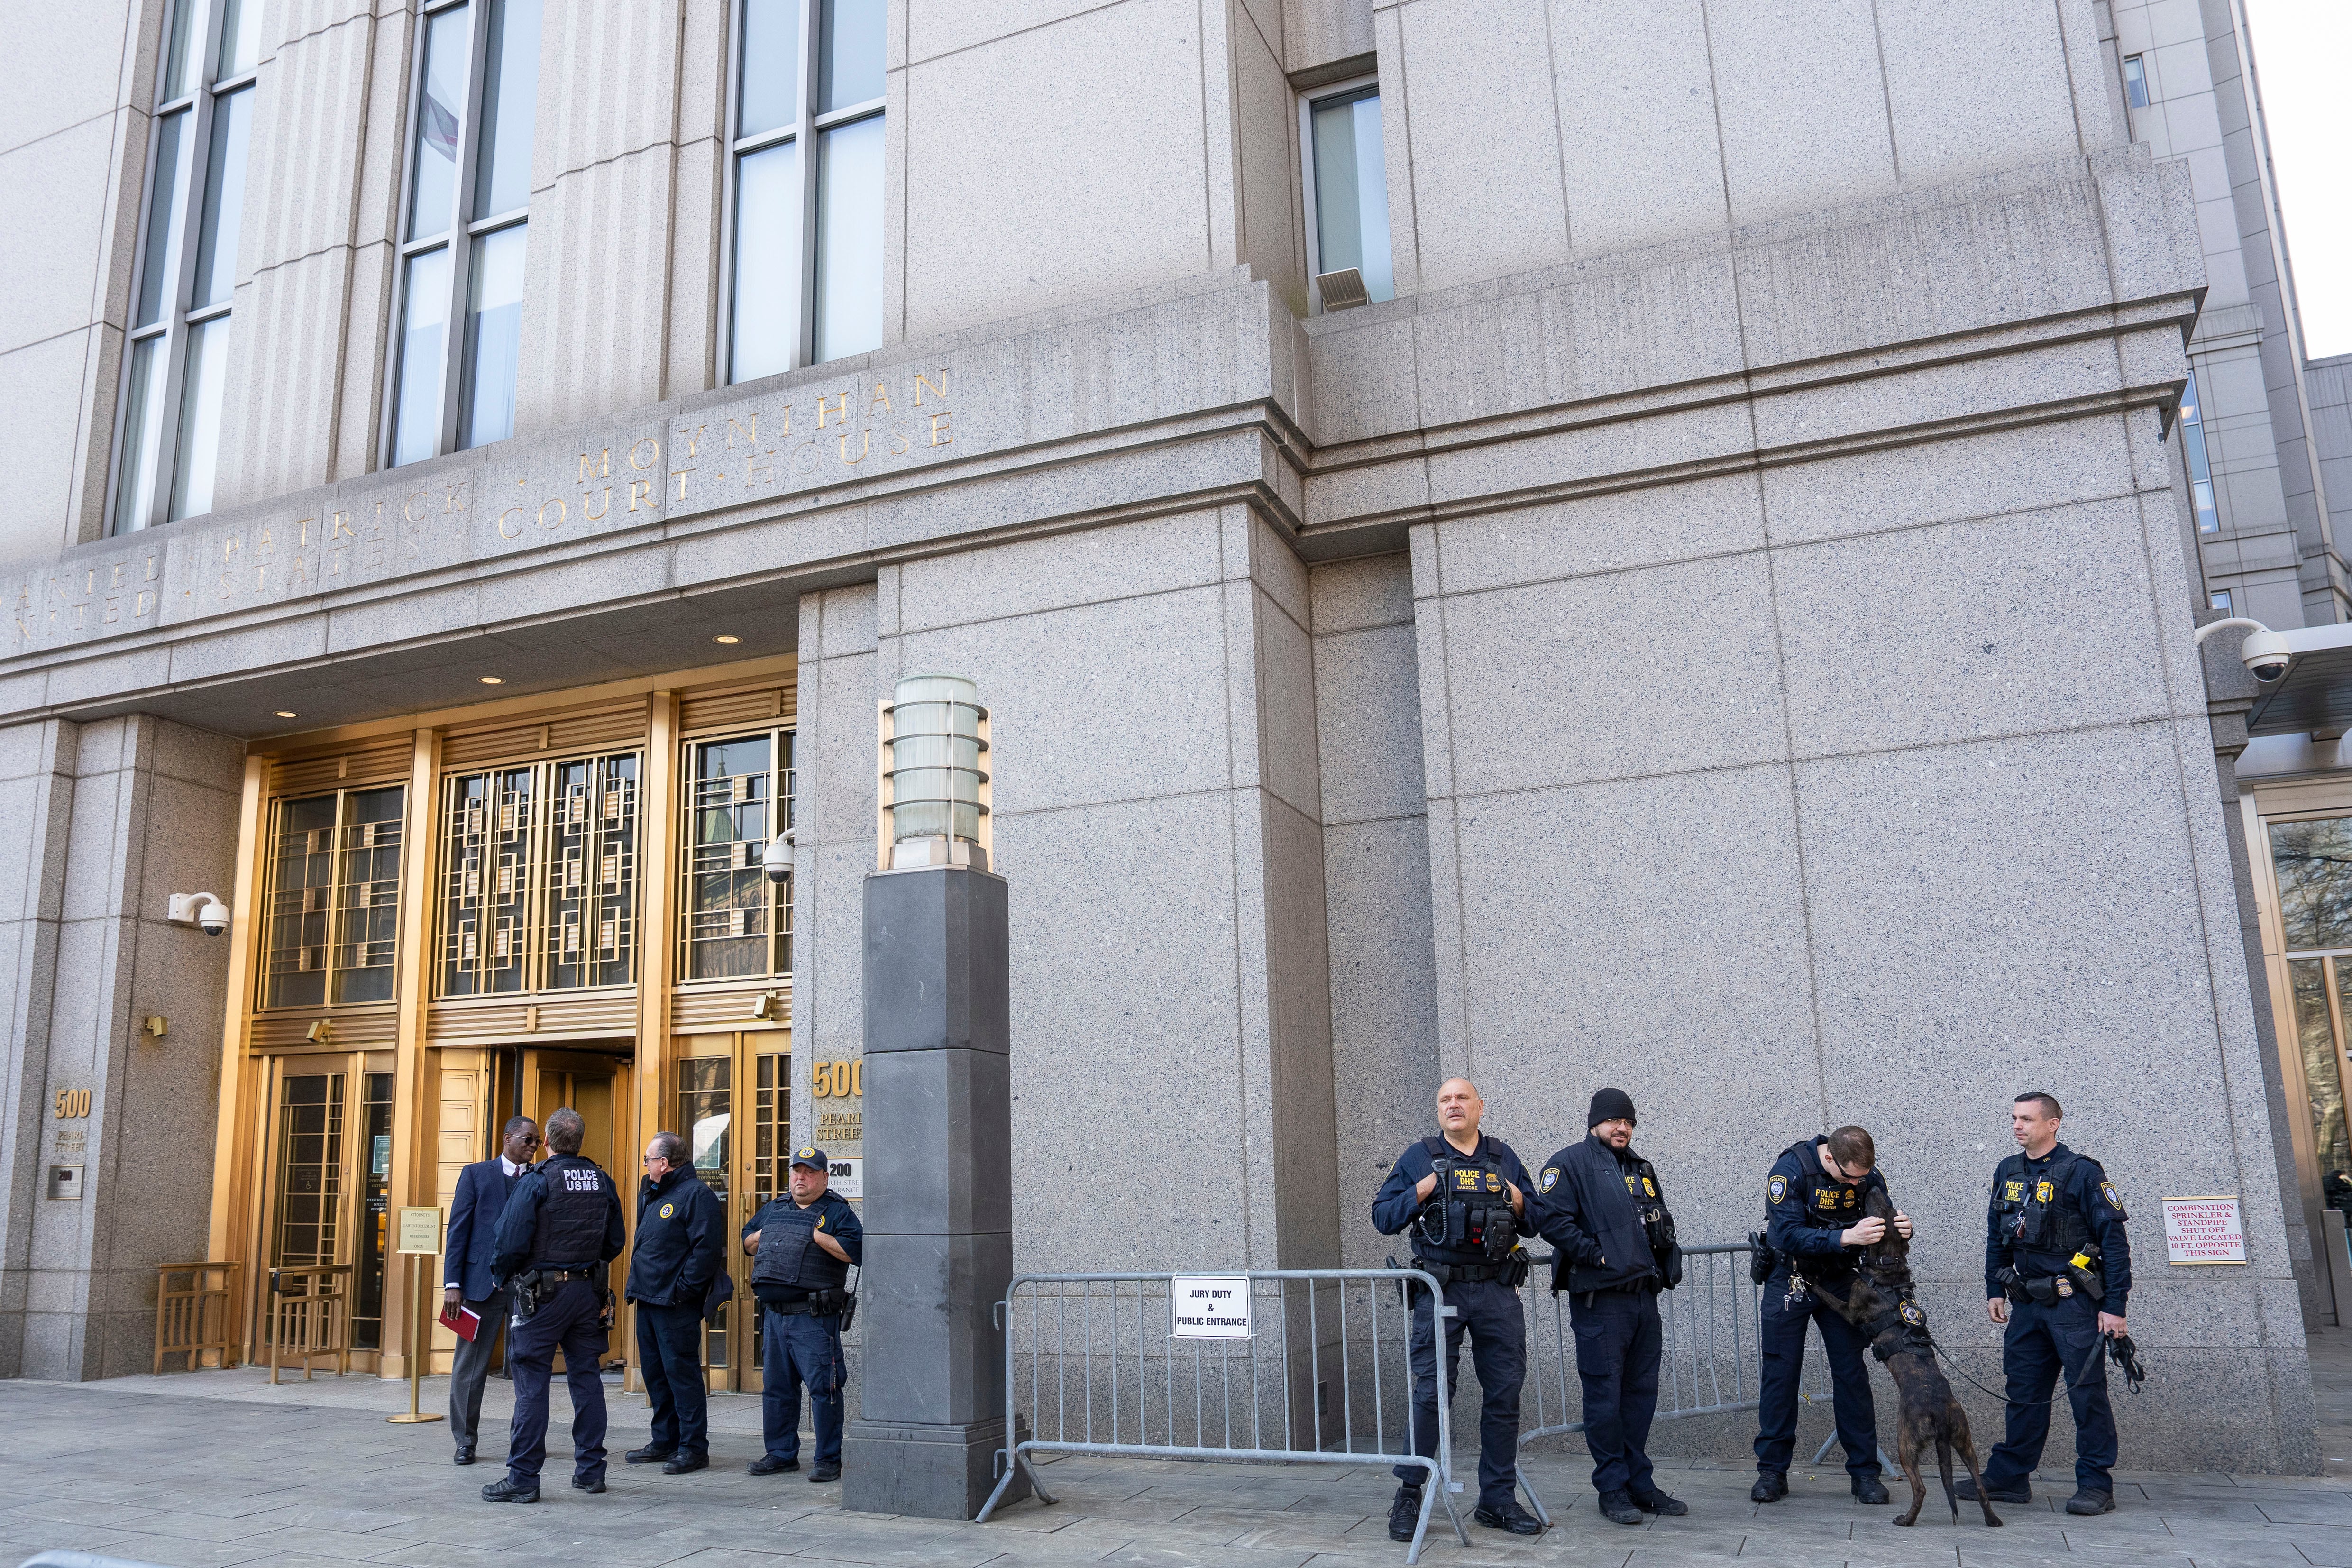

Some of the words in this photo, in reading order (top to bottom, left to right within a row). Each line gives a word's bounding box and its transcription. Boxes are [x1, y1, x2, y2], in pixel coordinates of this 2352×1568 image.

[0, 555, 159, 612] ANIEL
[224, 481, 468, 563] PATRICK
[577, 367, 949, 484] MOYNIHAN
[13, 590, 156, 643] NITED
[219, 529, 421, 600] STATES
[498, 468, 696, 540] COURT
[745, 411, 954, 488] HOUSE
[55, 1089, 91, 1119] 500
[821, 1113, 862, 1125] PEARL
[58, 1130, 83, 1140] PEARL
[816, 1128, 862, 1140] STREE
[55, 1142, 85, 1152] STREET
[563, 1169, 598, 1181] POLICE
[830, 1163, 851, 1177] 200
[1454, 1170, 1480, 1178] POLICE
[566, 1180, 599, 1191] USMS
[1460, 1177, 1475, 1186] DHS
[2005, 1181, 2024, 1191] POLICE
[1815, 1189, 1840, 1198] POLICE
[2007, 1189, 2019, 1197] DHS
[1820, 1197, 1834, 1205] DHS
[1190, 1290, 1209, 1298] JURY
[1212, 1290, 1232, 1298] DUTY
[1177, 1317, 1204, 1325] PUBLIC
[1206, 1318, 1247, 1326] ENTRANCE
